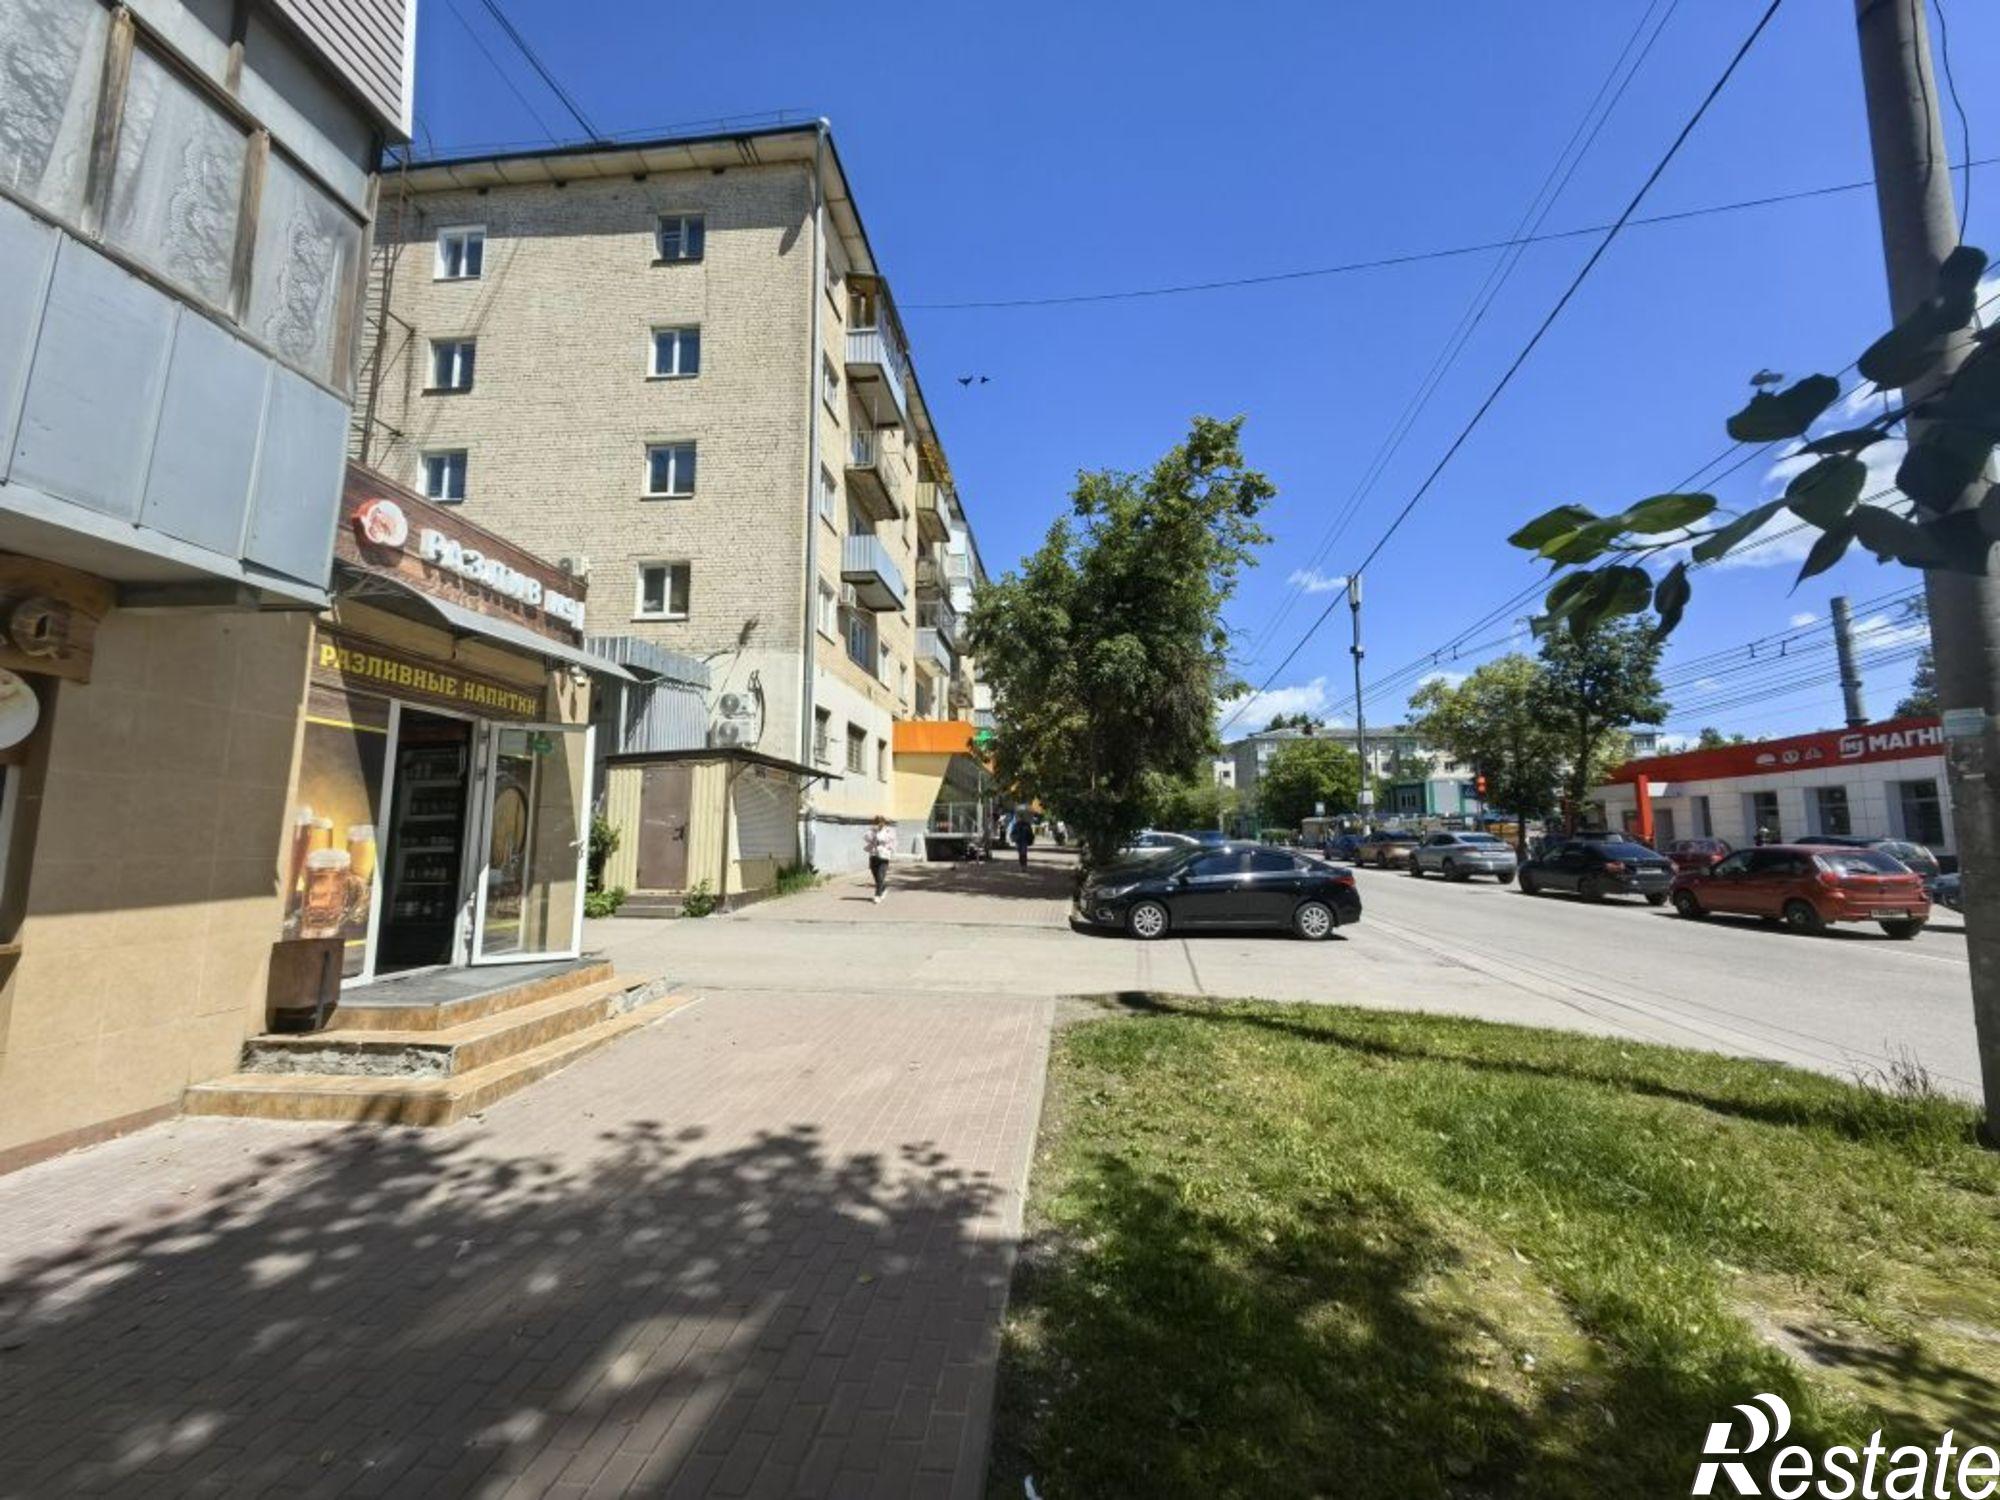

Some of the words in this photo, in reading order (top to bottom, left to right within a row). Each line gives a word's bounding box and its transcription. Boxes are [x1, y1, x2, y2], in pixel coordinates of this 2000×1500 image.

[420, 528, 541, 605] РАЗЛИВ
[319, 644, 457, 696] РАЗЛИВНЫЕ
[463, 682, 537, 716] НАПИТКИ
